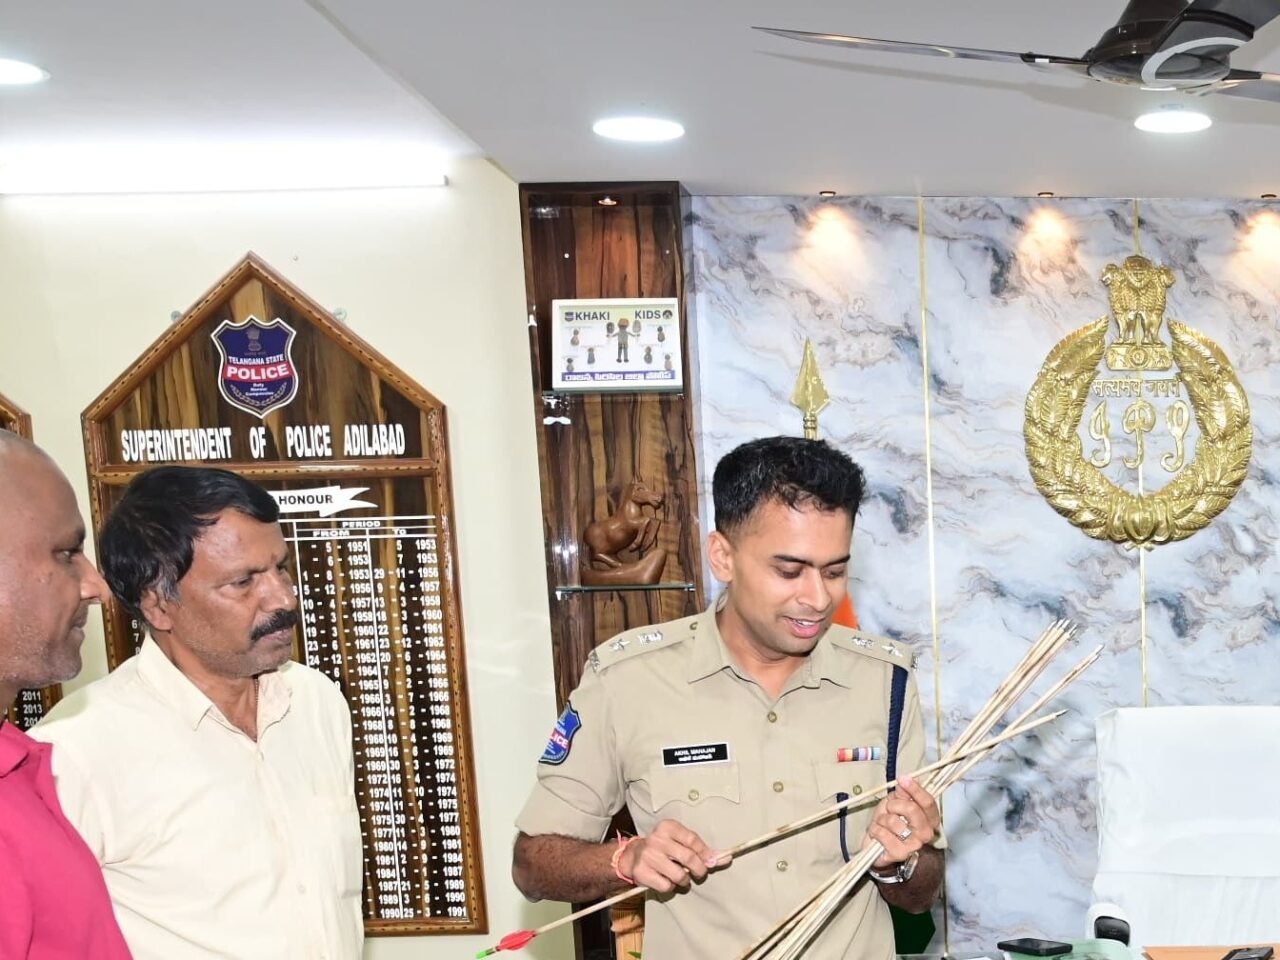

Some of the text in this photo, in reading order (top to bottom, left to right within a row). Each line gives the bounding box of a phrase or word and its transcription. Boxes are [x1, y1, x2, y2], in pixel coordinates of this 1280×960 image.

[575, 310, 660, 320] KHAKI KIDS
[228, 354, 284, 365] TELANGANA STATE
[226, 364, 289, 380] POLICE
[121, 424, 406, 462] SUPERINTENDENT OF POLICE ADILABAD
[278, 494, 333, 504] HONOUR
[342, 520, 380, 528] PERIOD
[326, 542, 332, 552] 5
[348, 541, 368, 552] 1951
[416, 539, 436, 549] 1953
[349, 556, 369, 565] 1953
[417, 553, 438, 563] 1953
[302, 570, 308, 581] 1
[350, 570, 370, 579] 1953
[304, 585, 310, 595] 5
[325, 584, 336, 594] 12
[420, 582, 440, 591] 1957
[303, 599, 313, 609] 10
[330, 599, 336, 609] 4
[351, 598, 371, 607] 1957
[304, 613, 314, 623] 14
[331, 612, 336, 622] 3
[132, 620, 138, 628] 6
[306, 627, 316, 637] 19
[332, 626, 337, 637] 3
[134, 634, 139, 642] 7
[307, 641, 318, 651] 23
[309, 655, 319, 665] 24
[331, 654, 342, 664] 12
[383, 667, 388, 677] 7
[22, 691, 40, 700] 2011
[385, 694, 391, 704] 3
[23, 704, 42, 714] 2013
[384, 707, 395, 717] 14
[24, 717, 42, 727] 201
[435, 759, 455, 769] 1972
[368, 774, 388, 784] 1972
[436, 773, 456, 782] 1974
[369, 788, 389, 798] 1974
[392, 788, 402, 798] 11
[437, 786, 457, 796] 1974
[370, 801, 390, 811] 1974
[393, 801, 403, 811] 11
[438, 799, 458, 809] 1975
[372, 815, 391, 824] 1975
[439, 813, 459, 822] 1977
[373, 828, 392, 837] 1977
[395, 828, 405, 838] 11
[397, 842, 407, 851] 14
[401, 855, 407, 864] 2
[402, 868, 406, 878] 1
[404, 895, 410, 904] 3
[445, 893, 465, 903] 1990
[380, 908, 400, 918] 1990
[448, 907, 466, 916] 1991
